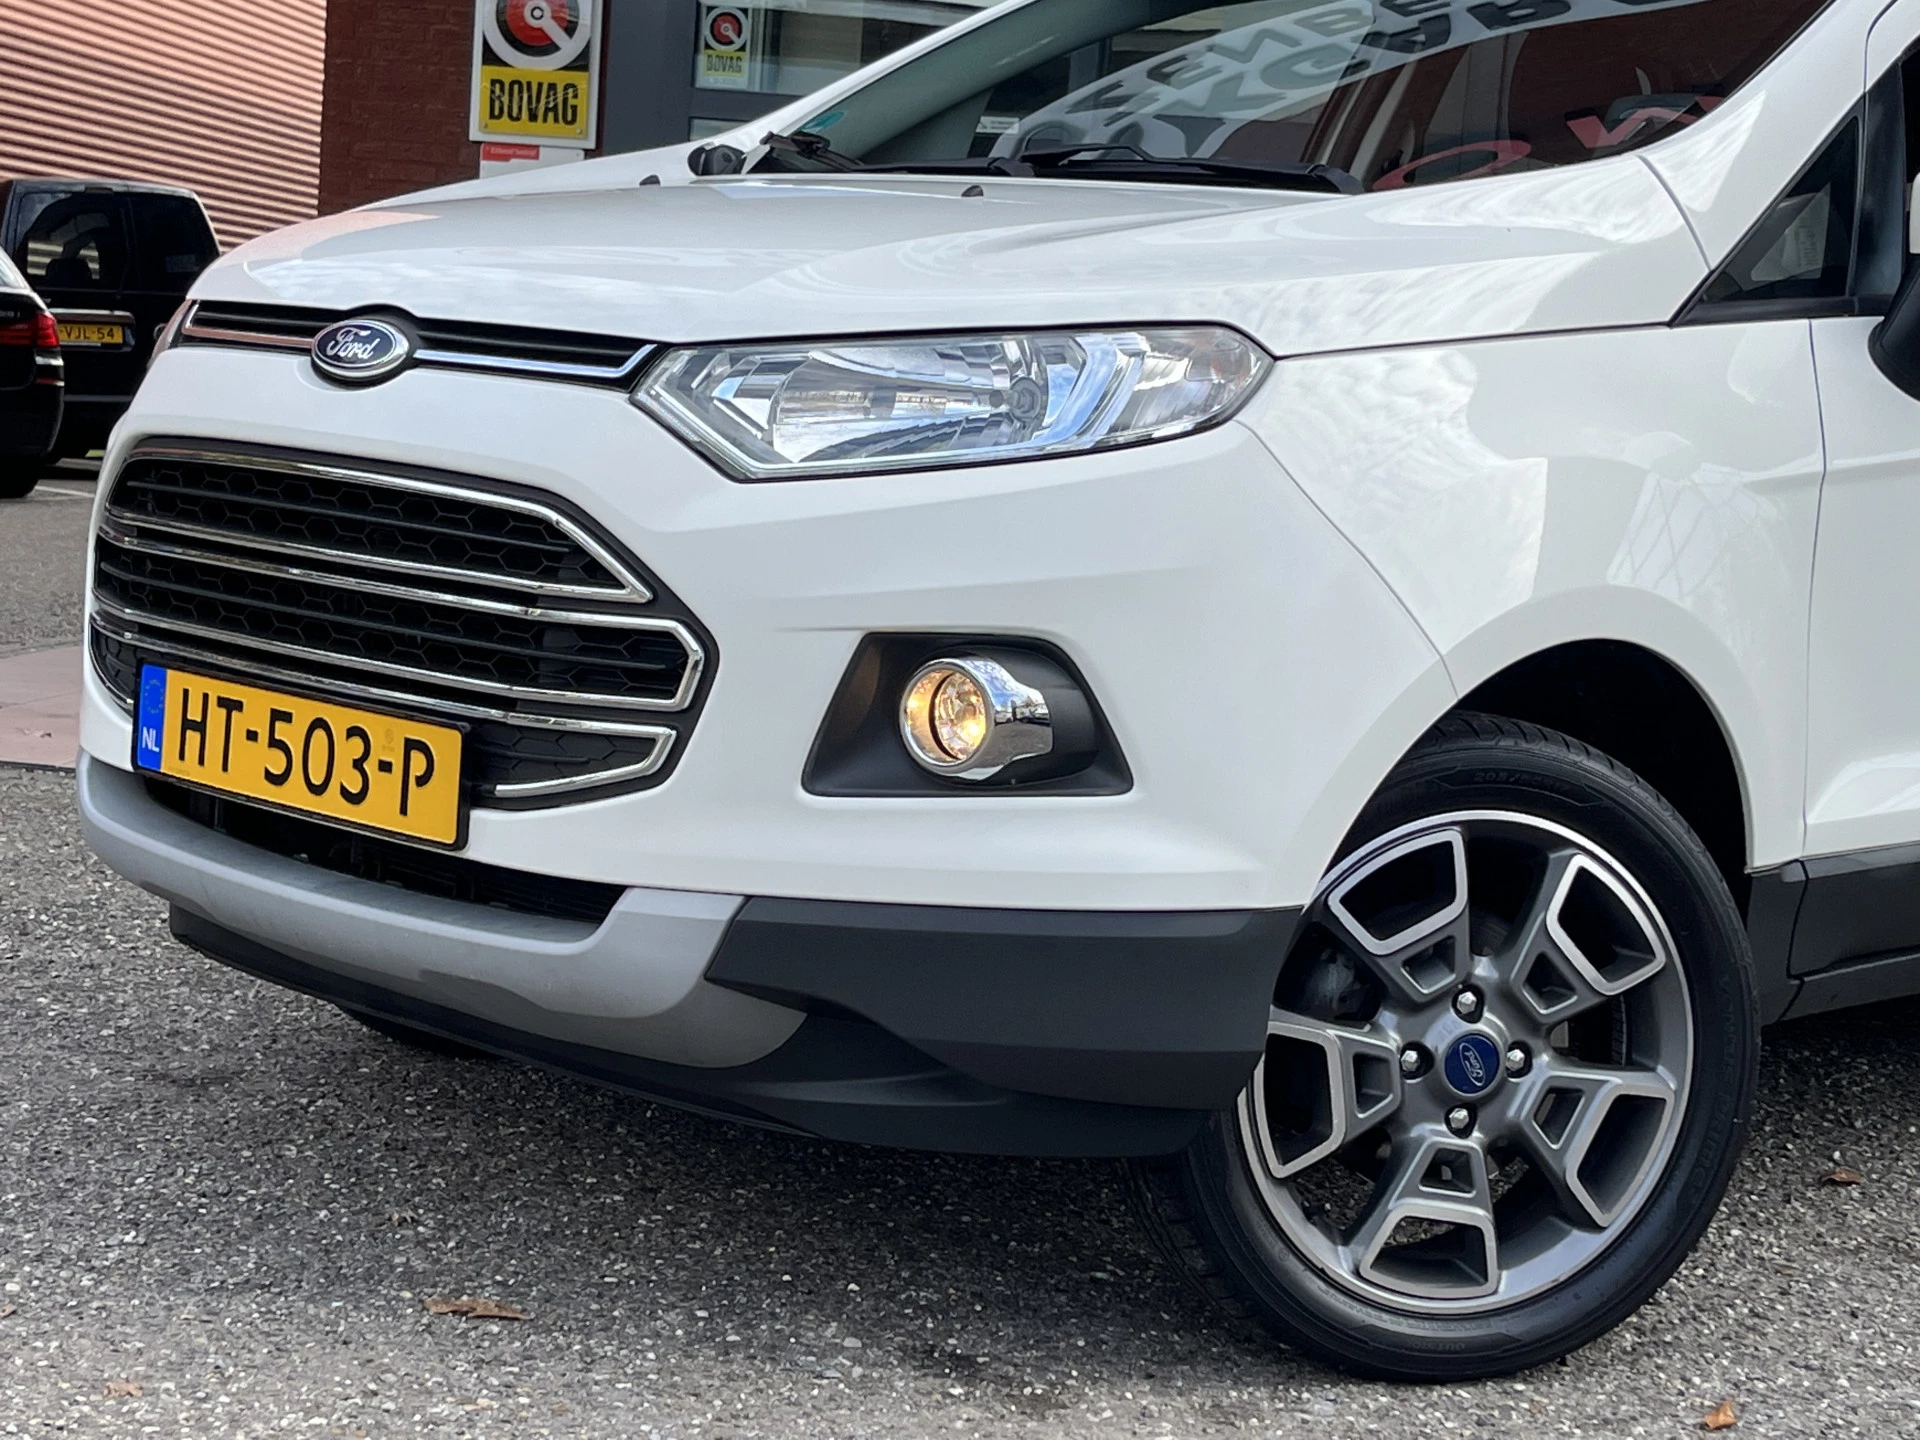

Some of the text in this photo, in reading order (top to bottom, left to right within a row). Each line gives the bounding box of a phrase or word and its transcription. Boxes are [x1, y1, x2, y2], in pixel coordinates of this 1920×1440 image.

[706, 54, 743, 74] BOVAG
[489, 78, 579, 126] BOVAG
[59, 326, 115, 341] -VJL-54
[325, 326, 381, 360] Ford
[141, 727, 160, 753] NL
[178, 688, 435, 817] HT-503-P
